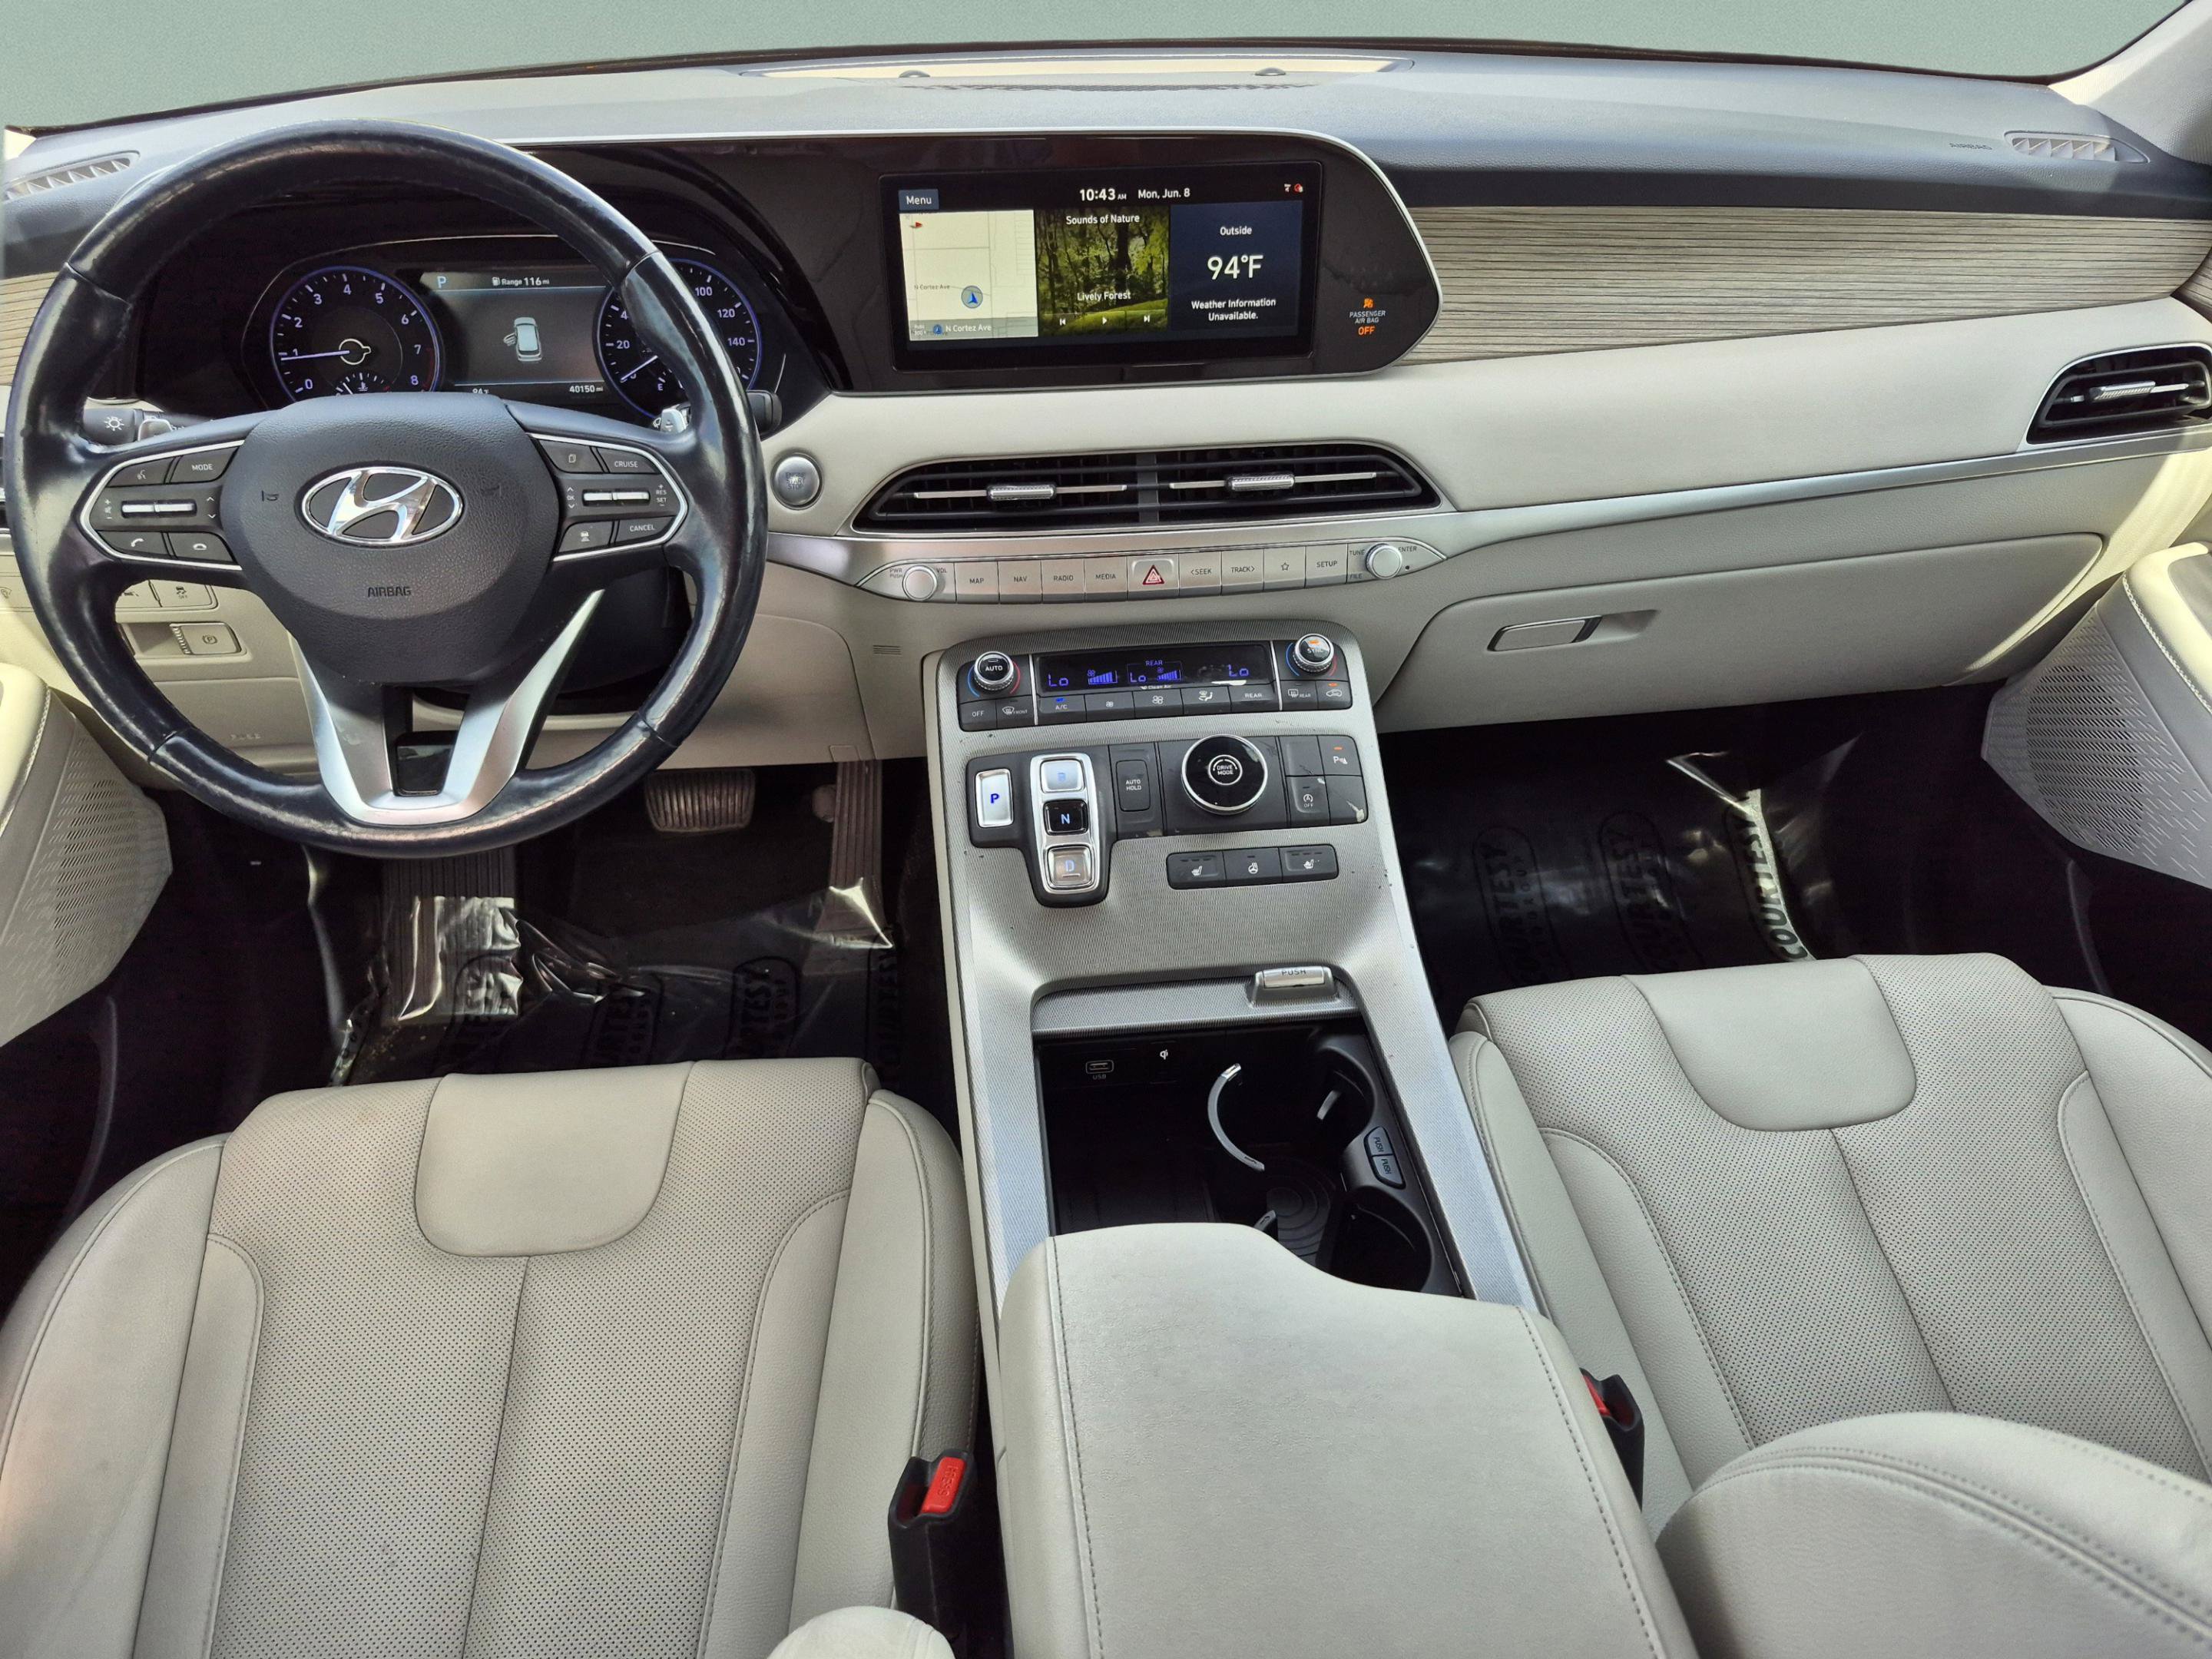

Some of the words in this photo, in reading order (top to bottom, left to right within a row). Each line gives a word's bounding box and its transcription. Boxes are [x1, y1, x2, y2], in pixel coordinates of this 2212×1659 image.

[1080, 188, 1115, 201] 10:43
[1137, 189, 1160, 199] Mon,
[1162, 189, 1181, 198] Jun.
[1184, 187, 1190, 197] 8
[906, 195, 932, 205] Menu
[1066, 215, 1098, 225] Sounds
[1100, 214, 1109, 224] of
[1111, 214, 1140, 224] Nature
[1220, 226, 1252, 235] Outside
[1207, 254, 1264, 280] 94°F
[437, 276, 447, 288] P
[501, 278, 522, 286] Range
[524, 276, 541, 286] 116
[343, 284, 352, 295] 4
[695, 286, 713, 296] 100
[314, 293, 323, 305] 3
[375, 293, 383, 304] 5
[1077, 292, 1101, 302] Lively
[1104, 290, 1131, 300] Forest
[1191, 300, 1227, 310] Weather
[1228, 297, 1276, 308] Information
[717, 309, 736, 318] 120
[1208, 310, 1258, 321] Unavailable.
[1349, 310, 1386, 318] PASSENGER
[294, 317, 303, 328] 2
[401, 314, 409, 325] 6
[953, 324, 976, 333] Cortez
[1358, 326, 1375, 336] OFF
[617, 340, 630, 349] 20
[727, 336, 745, 346] 140
[293, 348, 298, 356] 1
[414, 344, 422, 354] 7
[305, 379, 313, 389] 0
[410, 375, 419, 385] 8
[569, 385, 595, 393] 40150
[657, 383, 664, 392] E
[1316, 560, 1338, 568] SETUP
[368, 586, 412, 598] AIRBAG
[1048, 674, 1069, 687] Lo
[1130, 672, 1147, 683] Lo
[990, 793, 1000, 804] P
[1061, 813, 1071, 824] N
[1065, 859, 1075, 872] D
[1373, 1137, 1383, 1152] PUSH
[1382, 1158, 1392, 1174] PUSH
